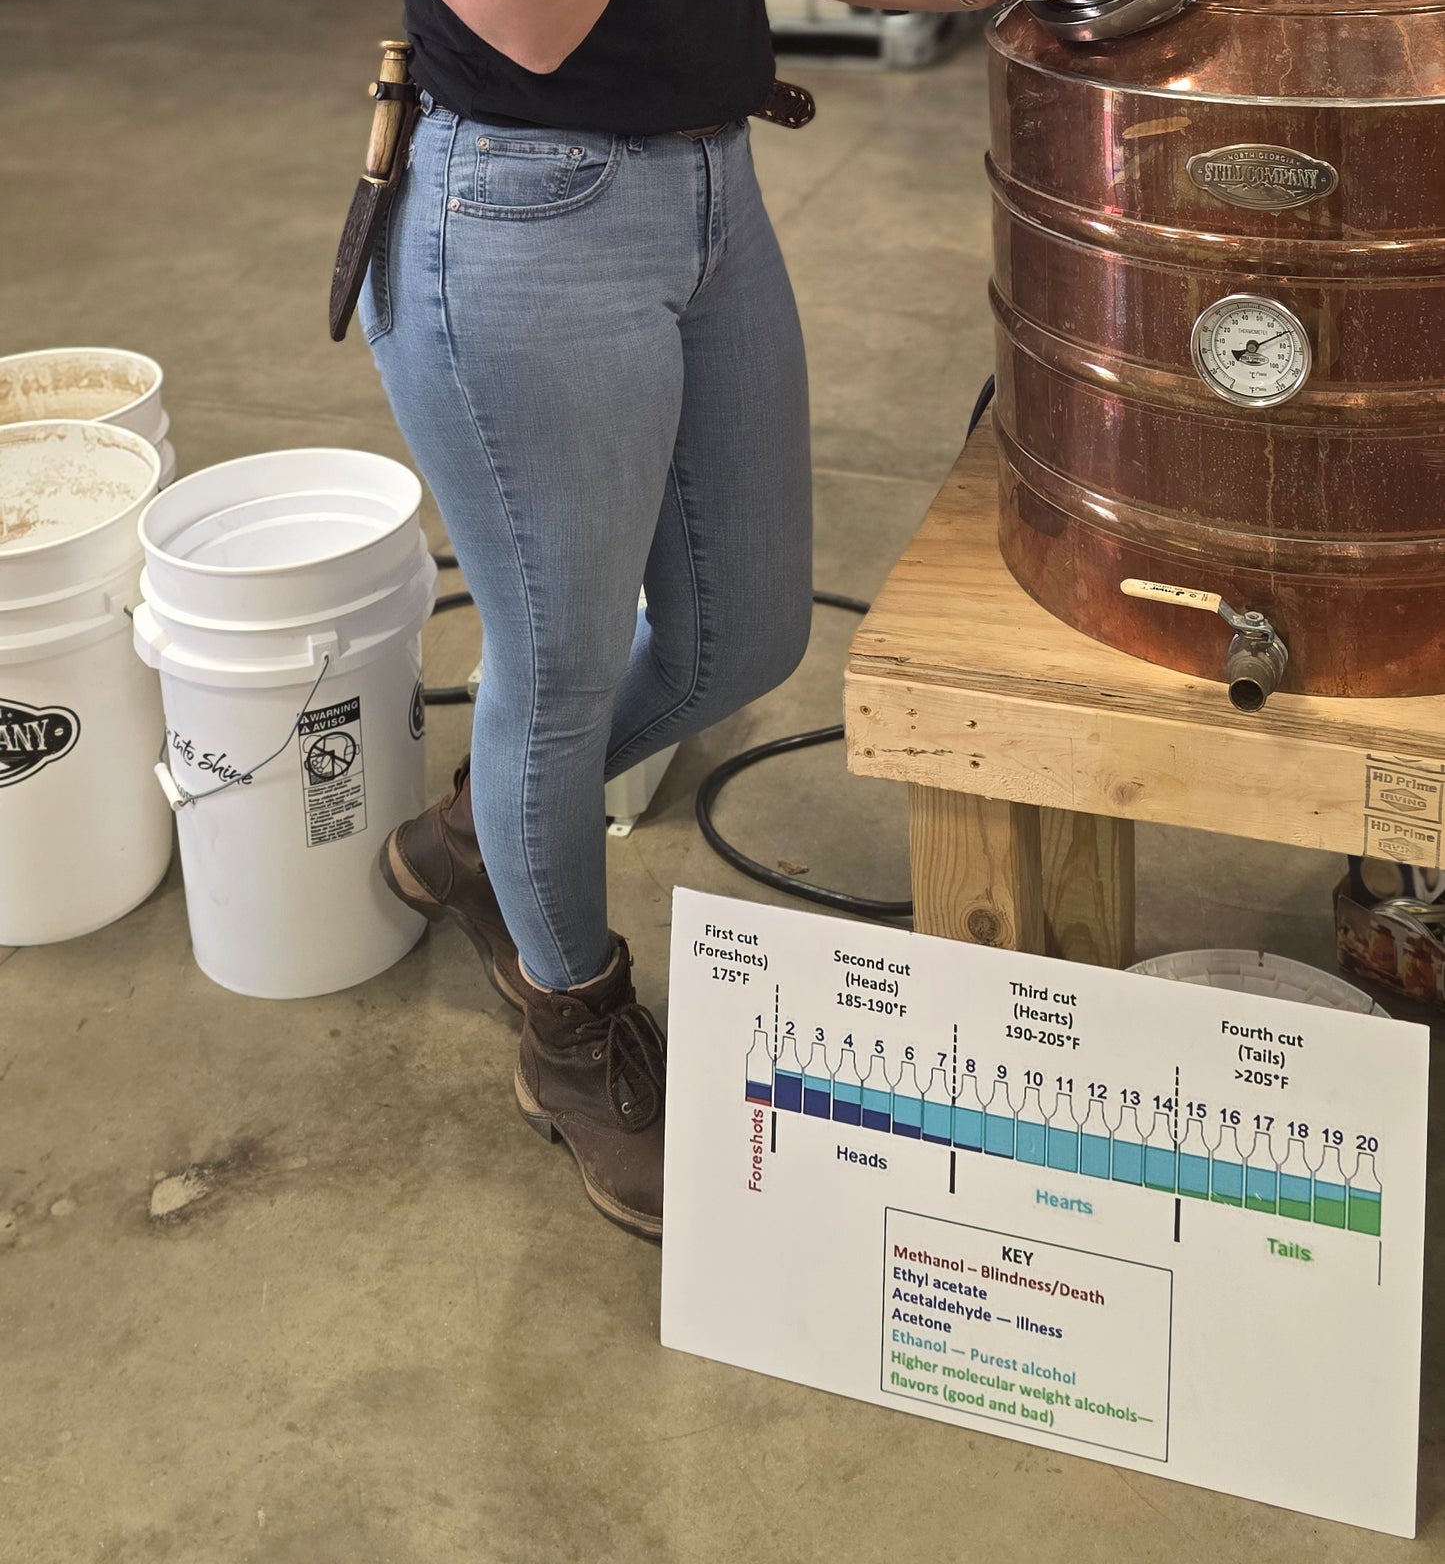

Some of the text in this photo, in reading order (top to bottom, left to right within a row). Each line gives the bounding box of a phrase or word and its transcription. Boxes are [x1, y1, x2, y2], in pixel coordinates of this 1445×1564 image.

[1227, 152, 1295, 165] NORTH GEORGIA
[1204, 162, 1319, 189] STILL COMPANY
[310, 701, 358, 722] WARNING
[313, 716, 346, 732] AVISO
[173, 731, 253, 785] Into Shine
[1372, 771, 1438, 793] HD Prime
[1380, 792, 1427, 808] IRVING
[1371, 820, 1435, 842] HD Prime
[705, 923, 759, 946] First cut
[693, 941, 769, 971] (Foreshots)
[833, 950, 911, 976] Second cut
[711, 966, 750, 986] 175°F
[845, 972, 899, 997] (Heads)
[836, 992, 908, 1018] 185-190°F
[1009, 982, 1077, 1006] Third cut
[1014, 1003, 1073, 1029] (Hearts)
[1005, 1025, 1080, 1050] 190-205°F
[1221, 1020, 1304, 1048] Fourth cut
[1238, 1044, 1286, 1069] (Tails)
[755, 1015, 1378, 1153] 1 2 3 4 5 6 7 8 9 10 11 12 13 14 15 16 17 18 19 20
[1234, 1069, 1289, 1090] >205°F
[748, 1108, 764, 1192] Foreshots
[836, 1145, 888, 1170] Heads
[1035, 1188, 1094, 1215] Hearts
[1001, 1246, 1034, 1266] KEY
[1267, 1237, 1314, 1262] Tails
[893, 1266, 988, 1300] Ethyl acetate
[894, 1245, 964, 1273] Methanol
[981, 1265, 1105, 1305] Blindness/Death
[892, 1287, 992, 1322] Acetaldehyde
[1016, 1316, 1063, 1338] Illness
[892, 1308, 952, 1333] Acetone
[892, 1329, 947, 1354] Ethanol
[970, 1348, 1018, 1371] Purest
[1021, 1361, 1076, 1385] alcohol
[891, 1350, 938, 1373] Higher
[942, 1366, 1016, 1392] molecular
[1019, 1384, 1071, 1406] weight
[890, 1371, 1055, 1427] flavors (good and bad)
